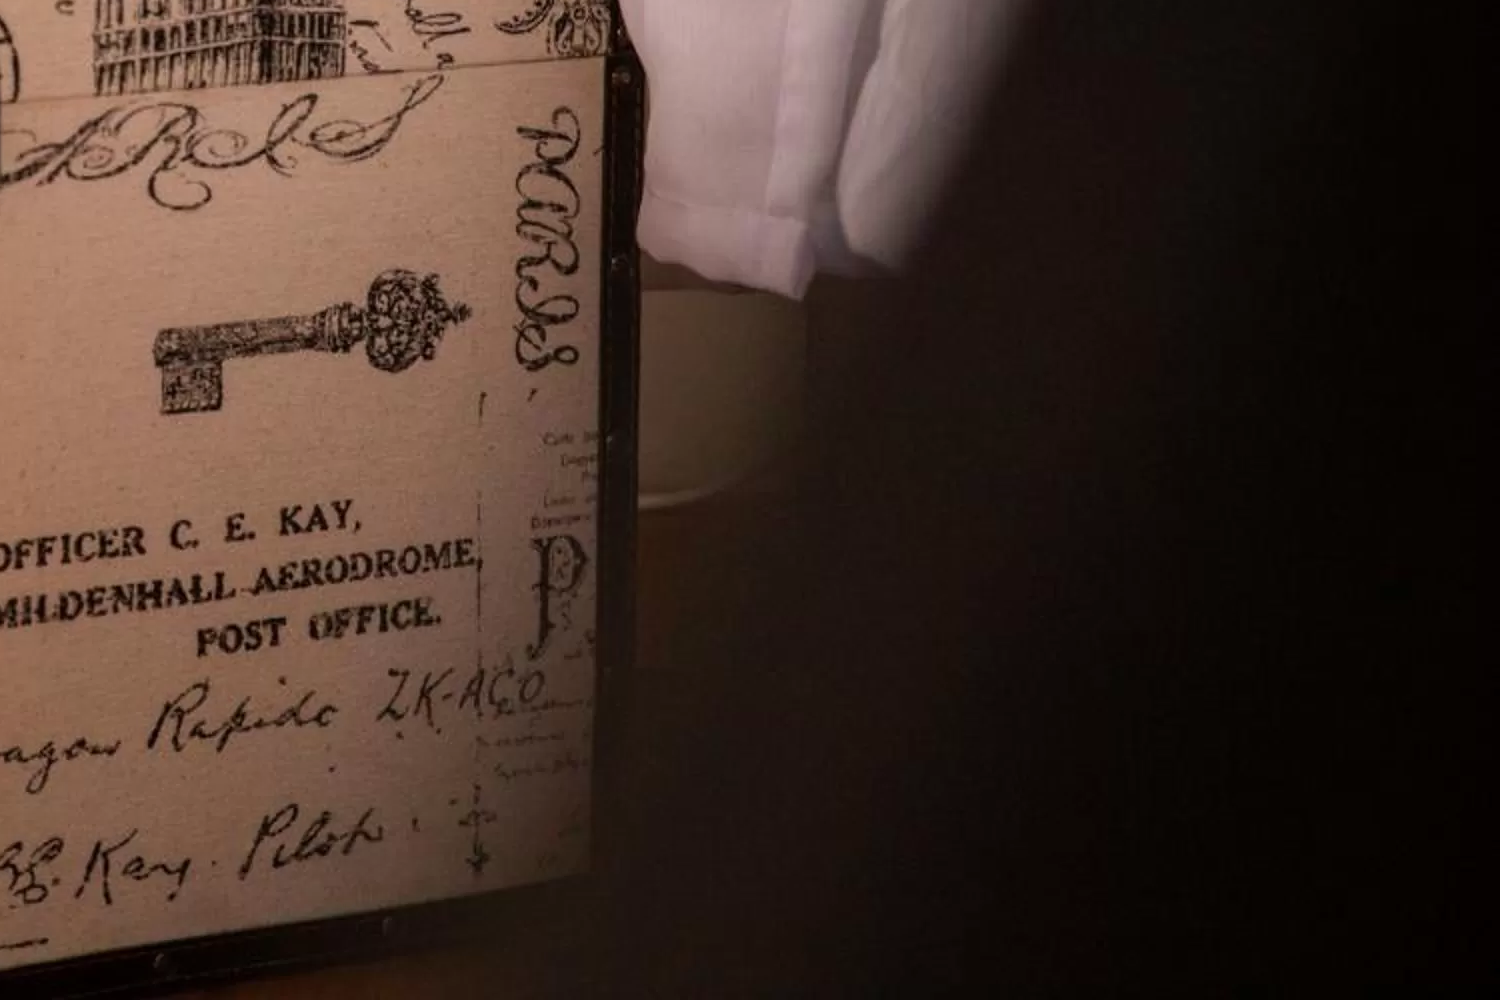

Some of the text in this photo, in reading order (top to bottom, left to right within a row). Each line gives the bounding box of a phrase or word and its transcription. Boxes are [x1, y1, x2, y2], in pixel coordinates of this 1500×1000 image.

[169, 519, 200, 550] C.
[224, 511, 256, 543] E.
[278, 498, 363, 536] KAY,
[250, 537, 484, 597] AERODROME,
[195, 597, 442, 658] POST OFFICE.
